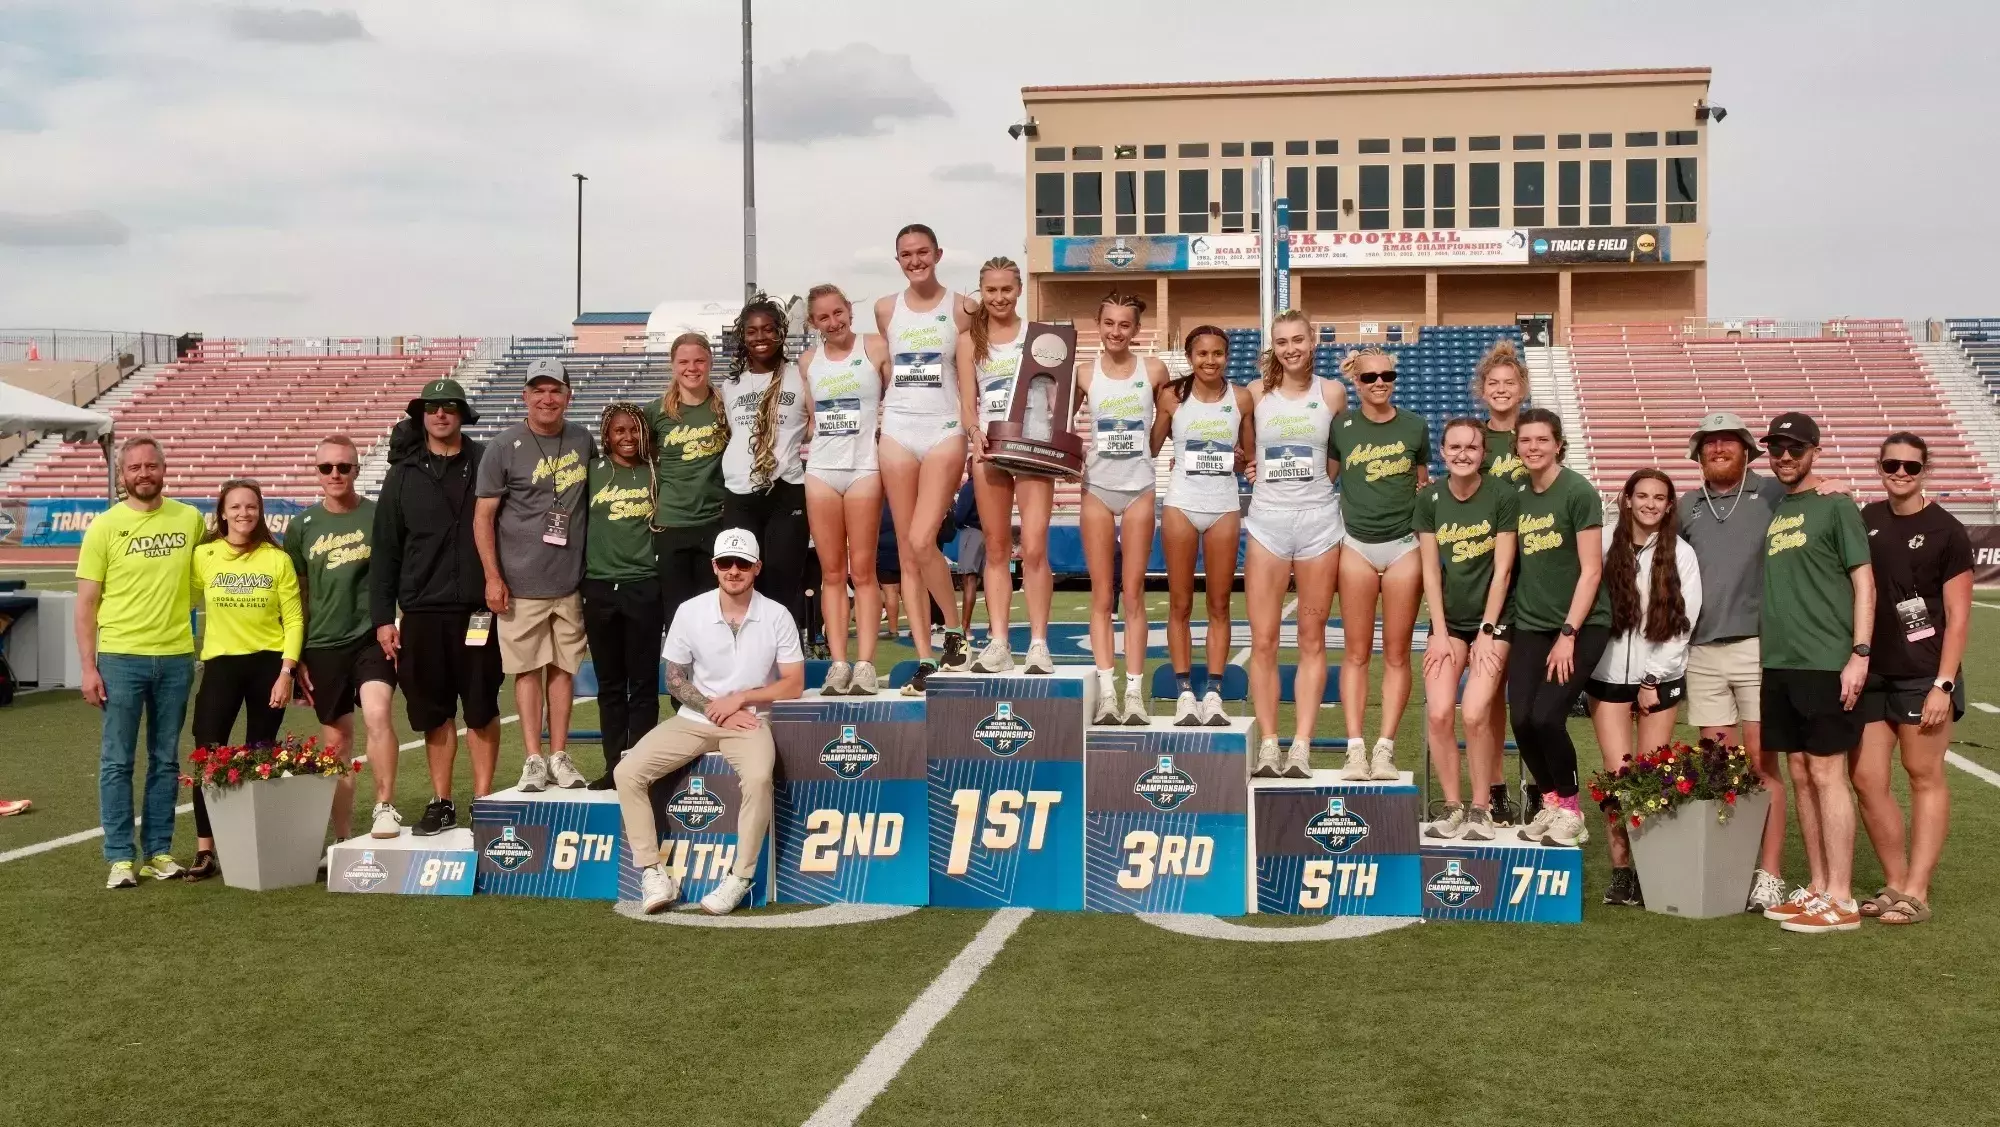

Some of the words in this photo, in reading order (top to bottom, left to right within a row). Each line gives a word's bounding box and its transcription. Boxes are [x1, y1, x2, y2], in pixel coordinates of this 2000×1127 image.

[1333, 231, 1460, 246] FOOTBALL
[1416, 243, 1503, 251] CHAMPIONSHIPS
[1551, 240, 1585, 251] TRACK
[1587, 240, 1595, 251] &
[1598, 239, 1628, 251] FIELD
[895, 374, 940, 383] SCHOELLKOPF
[819, 421, 857, 431] MCCLESKEY
[827, 413, 847, 421] MAGGIE
[1005, 443, 1032, 452] NATIONAL
[1033, 447, 1065, 459] RUNNER-UP
[1107, 441, 1134, 450] SPENCE
[1345, 440, 1406, 471] Adams
[531, 449, 579, 485] Adams
[1196, 461, 1223, 470] ROBLES
[1268, 467, 1310, 478] HOOGSTEEN
[1365, 455, 1412, 482] State
[590, 485, 649, 508] Adams
[1435, 519, 1492, 546] Adams
[125, 532, 186, 557] ADAMS
[309, 529, 365, 560] Adams
[1523, 530, 1563, 556] State
[1768, 530, 1807, 556] State
[144, 547, 171, 558] STATE
[326, 544, 372, 570] State
[210, 572, 273, 590] ADAMS
[975, 730, 1033, 739] CHAMPIONSHIPS
[821, 753, 877, 762] CHAMPIONSHIPS
[1136, 784, 1195, 793] CHAMPIONSHIPS
[668, 804, 724, 814] CHAMPIONSHIPS
[947, 789, 1062, 875] 1ST
[1307, 826, 1367, 835] CHAMPIONSHIPS
[800, 809, 904, 871] 2ND
[486, 849, 531, 857] CHAMPIONSHIPS
[553, 831, 614, 870] 6TH
[1117, 830, 1214, 889] 3RD
[659, 839, 736, 885] 4TH
[420, 859, 466, 887] 8TH
[1299, 860, 1378, 908] 5TH
[1428, 884, 1479, 893] CHAMPIONSHIPS
[1510, 867, 1570, 904] 7TH
